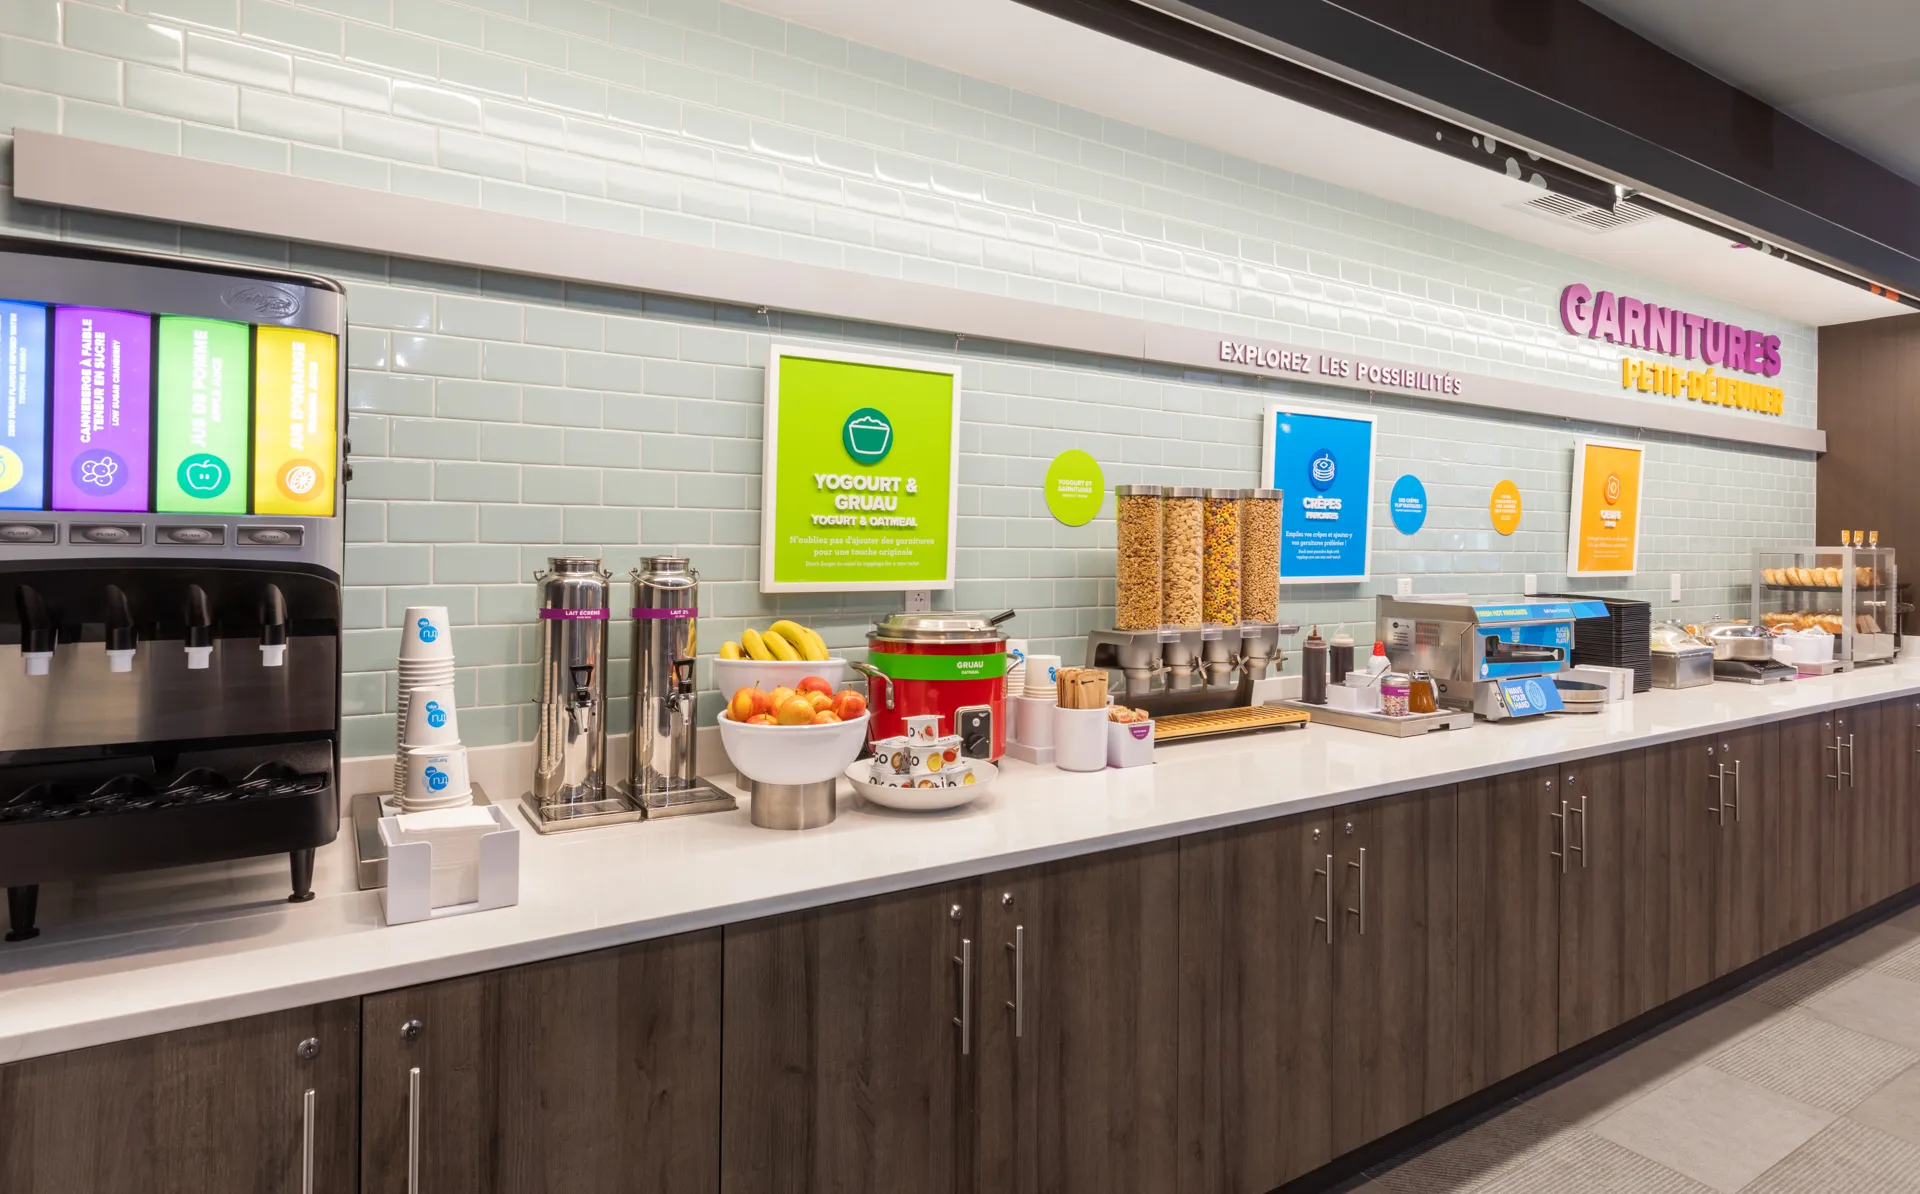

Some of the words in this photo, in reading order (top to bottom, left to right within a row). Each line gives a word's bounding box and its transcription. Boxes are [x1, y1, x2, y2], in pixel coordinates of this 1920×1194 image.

[82, 318, 92, 356] FAIBLE
[1560, 283, 1782, 377] GARNITURES
[94, 332, 106, 369] SUCRE
[192, 330, 208, 390] POMME
[79, 358, 92, 368] À
[112, 340, 120, 384] CRANBERRY
[1220, 340, 1311, 373] EXPLOREZ
[1320, 355, 1350, 377] LES
[1356, 362, 1462, 395] POSSIBILITÉS
[94, 370, 105, 386] EN
[290, 342, 306, 420] D'ORANGE
[1623, 357, 1784, 415] PETIT-DÉJEUNER
[80, 368, 92, 443] CANNEBERGE
[112, 384, 120, 410] SUGAR
[192, 394, 206, 414] DE
[93, 388, 104, 432] TENEUR
[112, 410, 120, 426] LOW
[190, 418, 206, 448] JUS
[290, 422, 304, 452] JUS
[814, 474, 901, 492] YOGOURT
[906, 478, 918, 493] &
[834, 495, 898, 511] GRUAU
[1303, 495, 1342, 510] CRÊPES
[810, 515, 856, 526] YOGURT
[860, 516, 867, 526] &
[870, 516, 918, 527] OATMEAL
[790, 536, 827, 544] N'oubliez
[846, 536, 879, 546] d'ajouter
[881, 537, 894, 545] des
[896, 537, 934, 546] garnitures
[814, 549, 832, 557] pour
[879, 548, 912, 557] originale
[423, 630, 437, 639] tru
[1506, 686, 1523, 695] WAVE
[1514, 701, 1530, 709] HAND
[432, 713, 446, 723] tru
[433, 776, 448, 786] tru
